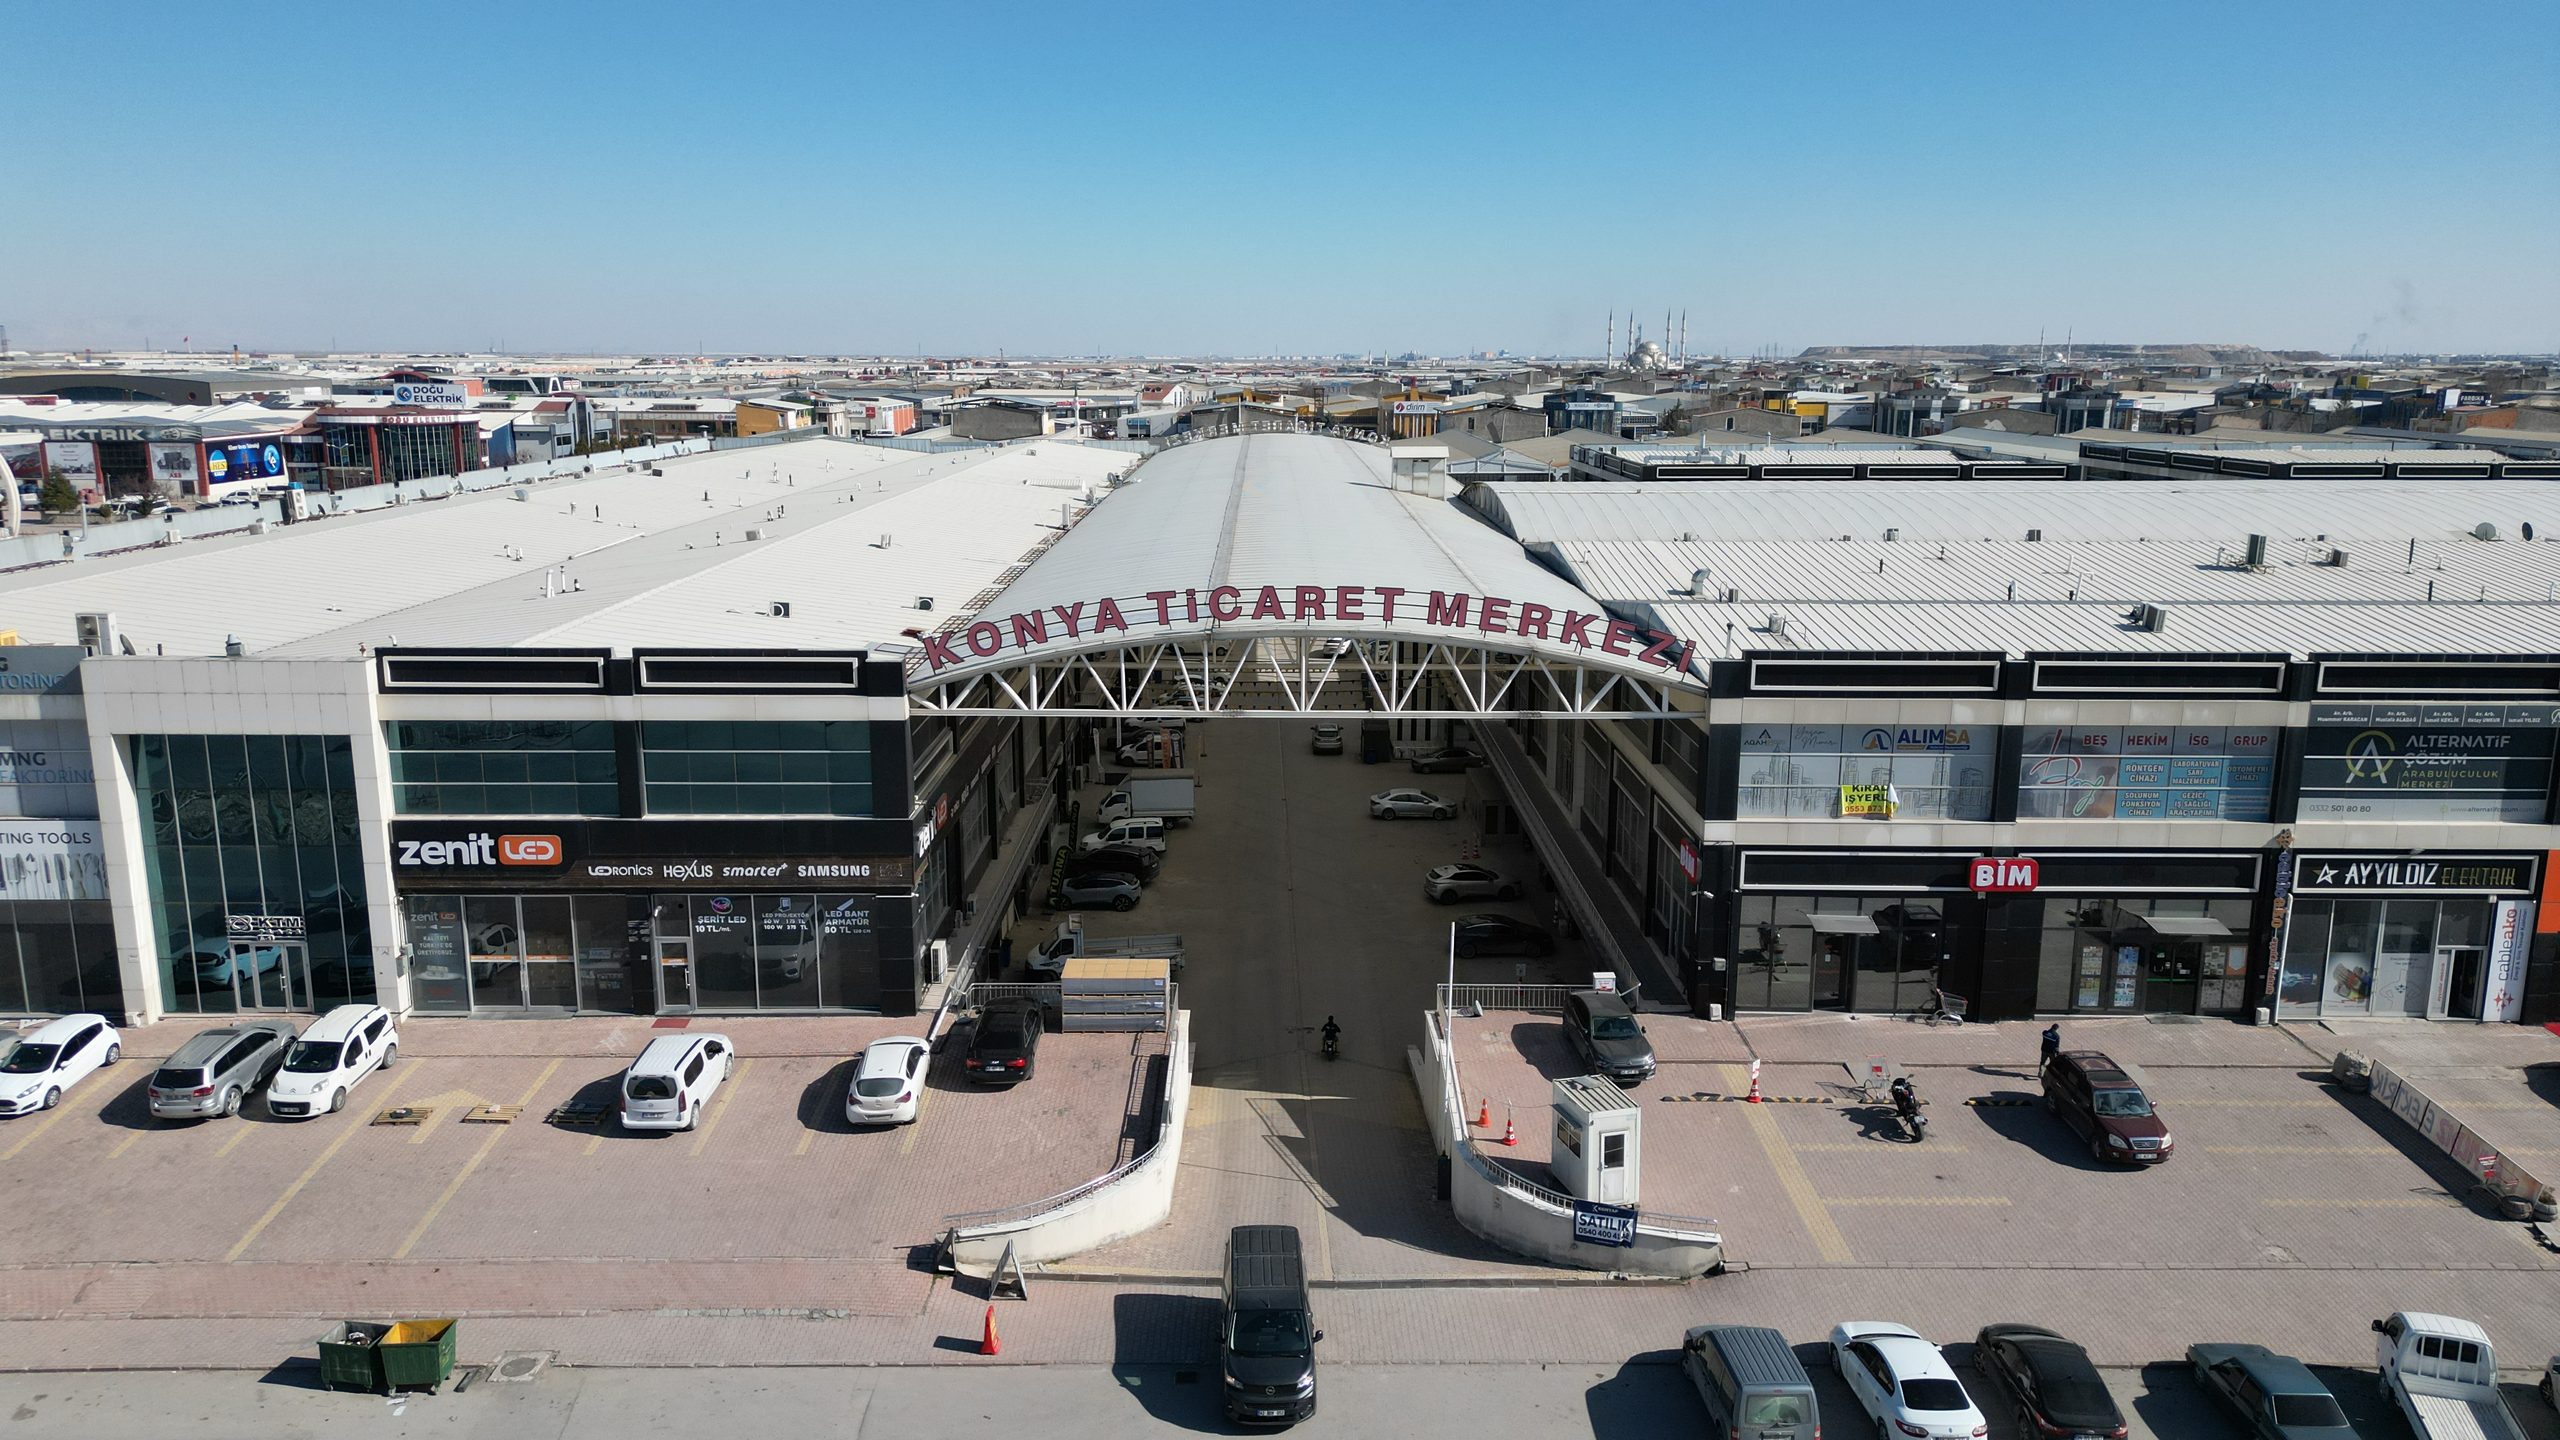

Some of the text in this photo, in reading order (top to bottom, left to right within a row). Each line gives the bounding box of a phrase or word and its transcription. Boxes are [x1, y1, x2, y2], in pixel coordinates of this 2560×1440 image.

[413, 384, 444, 394] DOĞU
[414, 395, 463, 404] ELEKTRİK
[923, 584, 1696, 673] KONYA TİCARET MERKEZİ
[1897, 729, 1970, 743] ALIMSA
[2083, 734, 2268, 747] BEŞ HEKİM İSG GRUP
[2405, 735, 2511, 748] ALTERNATİF
[2125, 764, 2164, 772] RÖNTGEN
[2402, 770, 2499, 778] ARABULUCULUK
[38, 832, 91, 844] TOOLS
[398, 833, 555, 865] zenit LED
[798, 865, 870, 877] SAMSUNG
[1976, 860, 2032, 887] BİM
[2345, 863, 2440, 885] AYYILDIZ
[259, 917, 300, 928] KTM
[410, 912, 439, 921] zenit
[698, 915, 725, 924] ŞERİT
[2498, 908, 2518, 981] cableako
[1579, 1213, 1631, 1232] SATILIK
[1578, 1227, 1597, 1236] 0540
[1597, 1230, 1612, 1238] 400
